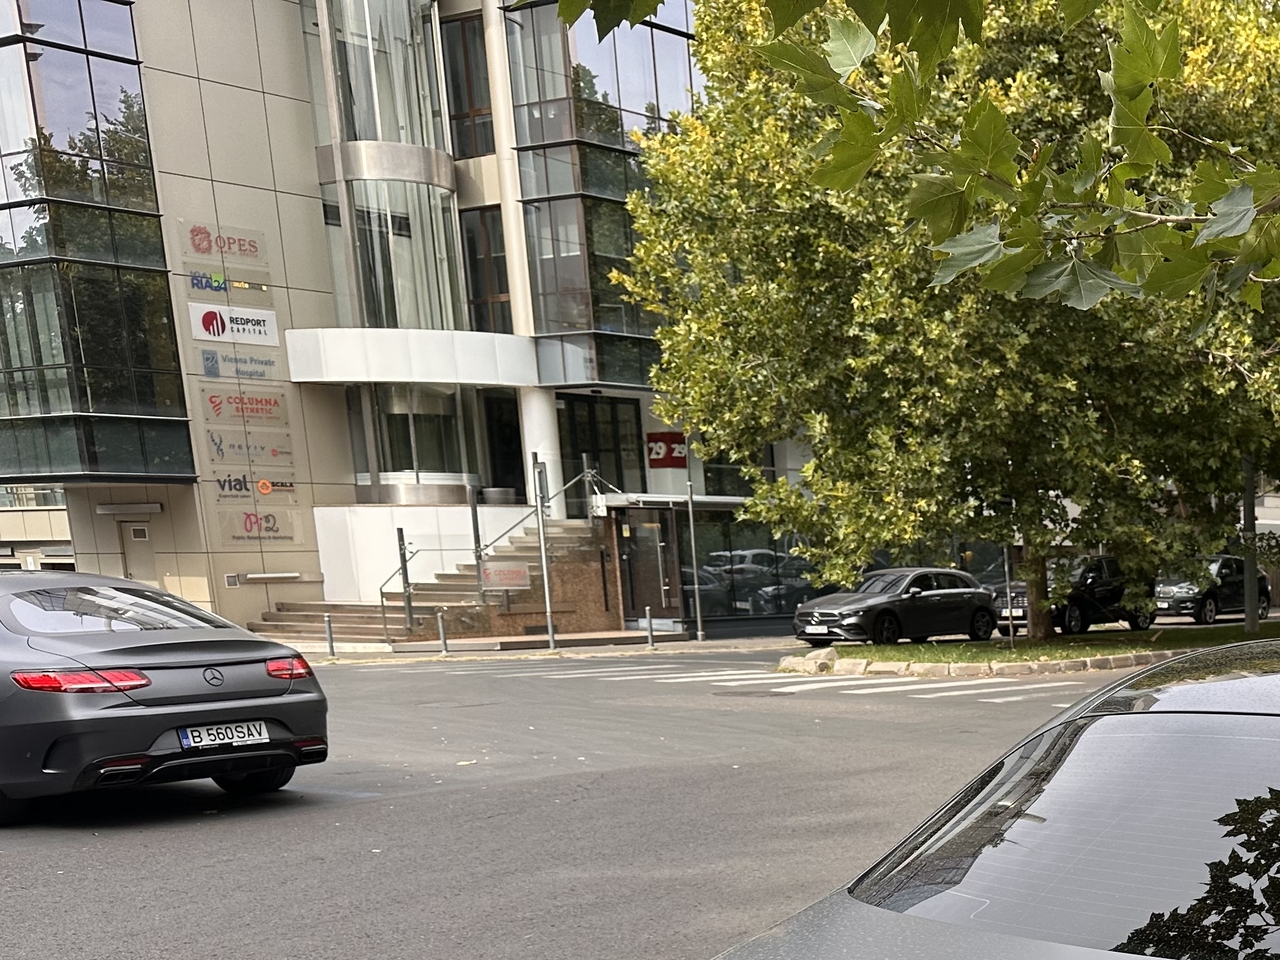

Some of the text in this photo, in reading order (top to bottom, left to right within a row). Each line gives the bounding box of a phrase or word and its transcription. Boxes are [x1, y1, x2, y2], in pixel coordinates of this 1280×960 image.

[215, 235, 258, 253] OPES
[229, 316, 266, 328] REDPORT
[230, 326, 268, 336] CAPITAL
[221, 354, 276, 367] Vienna Private
[235, 368, 266, 379] Hospital
[226, 396, 279, 407] COLUMNA
[648, 442, 667, 459] 29
[671, 443, 687, 458] 29
[216, 473, 250, 492] vial
[190, 729, 203, 744] B
